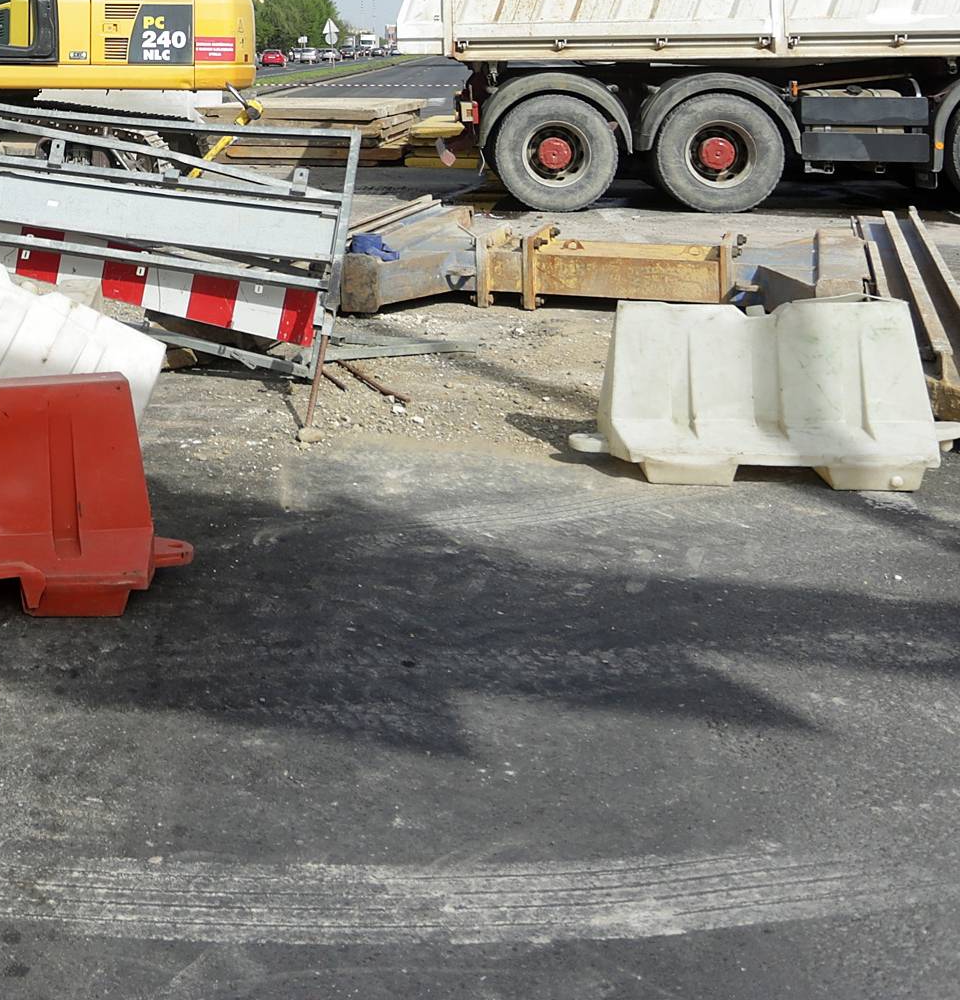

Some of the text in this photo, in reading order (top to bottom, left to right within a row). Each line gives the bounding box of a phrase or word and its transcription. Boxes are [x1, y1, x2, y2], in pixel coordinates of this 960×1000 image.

[143, 16, 165, 29] PC
[141, 30, 187, 49] 240
[143, 49, 171, 61] NLC
